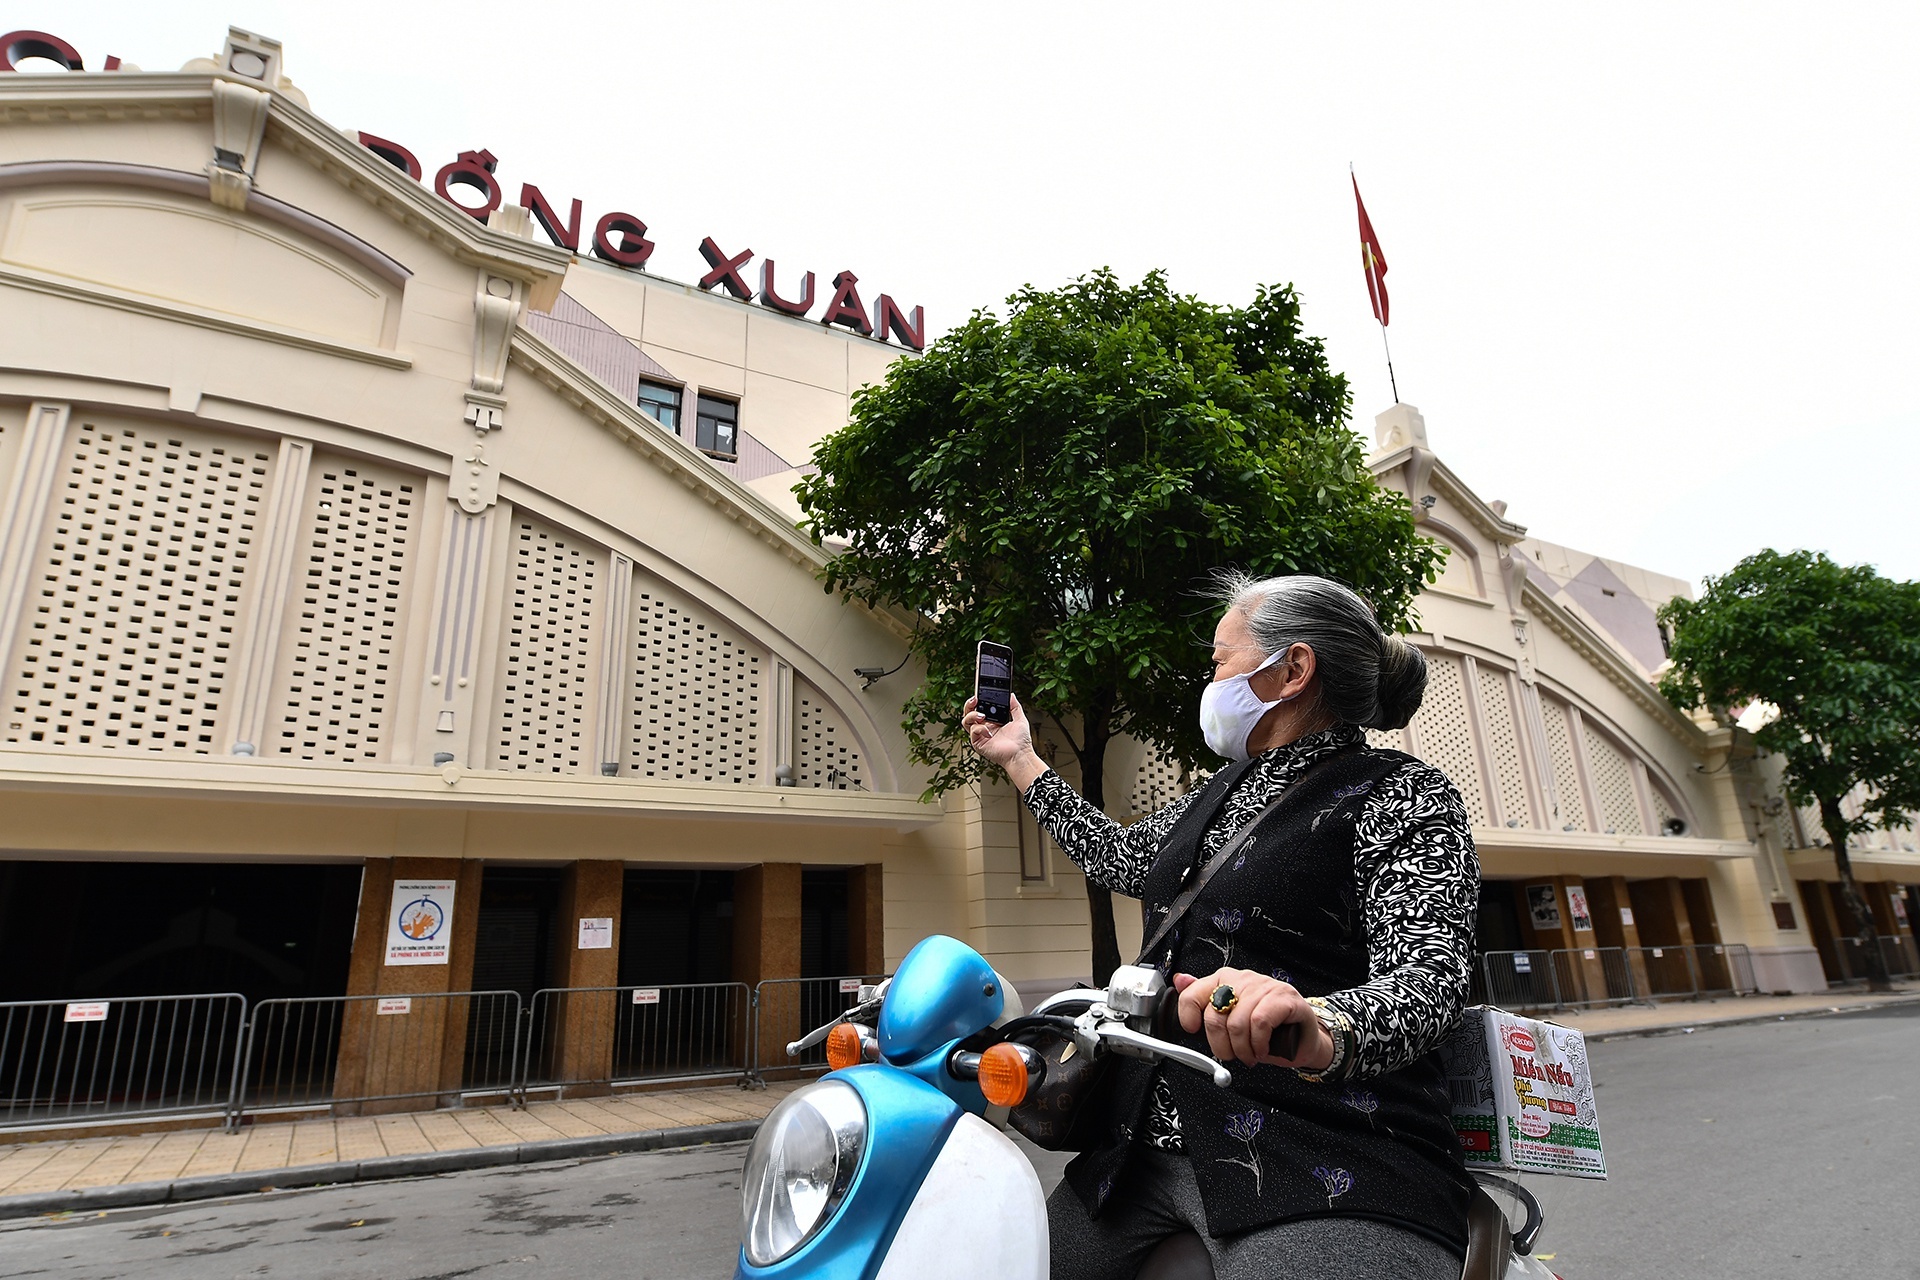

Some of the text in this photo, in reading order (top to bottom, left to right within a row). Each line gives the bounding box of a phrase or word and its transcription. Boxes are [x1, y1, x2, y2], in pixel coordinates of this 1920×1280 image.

[699, 236, 925, 350] XUÂN
[1510, 1054, 1575, 1087] Miến Nấu
